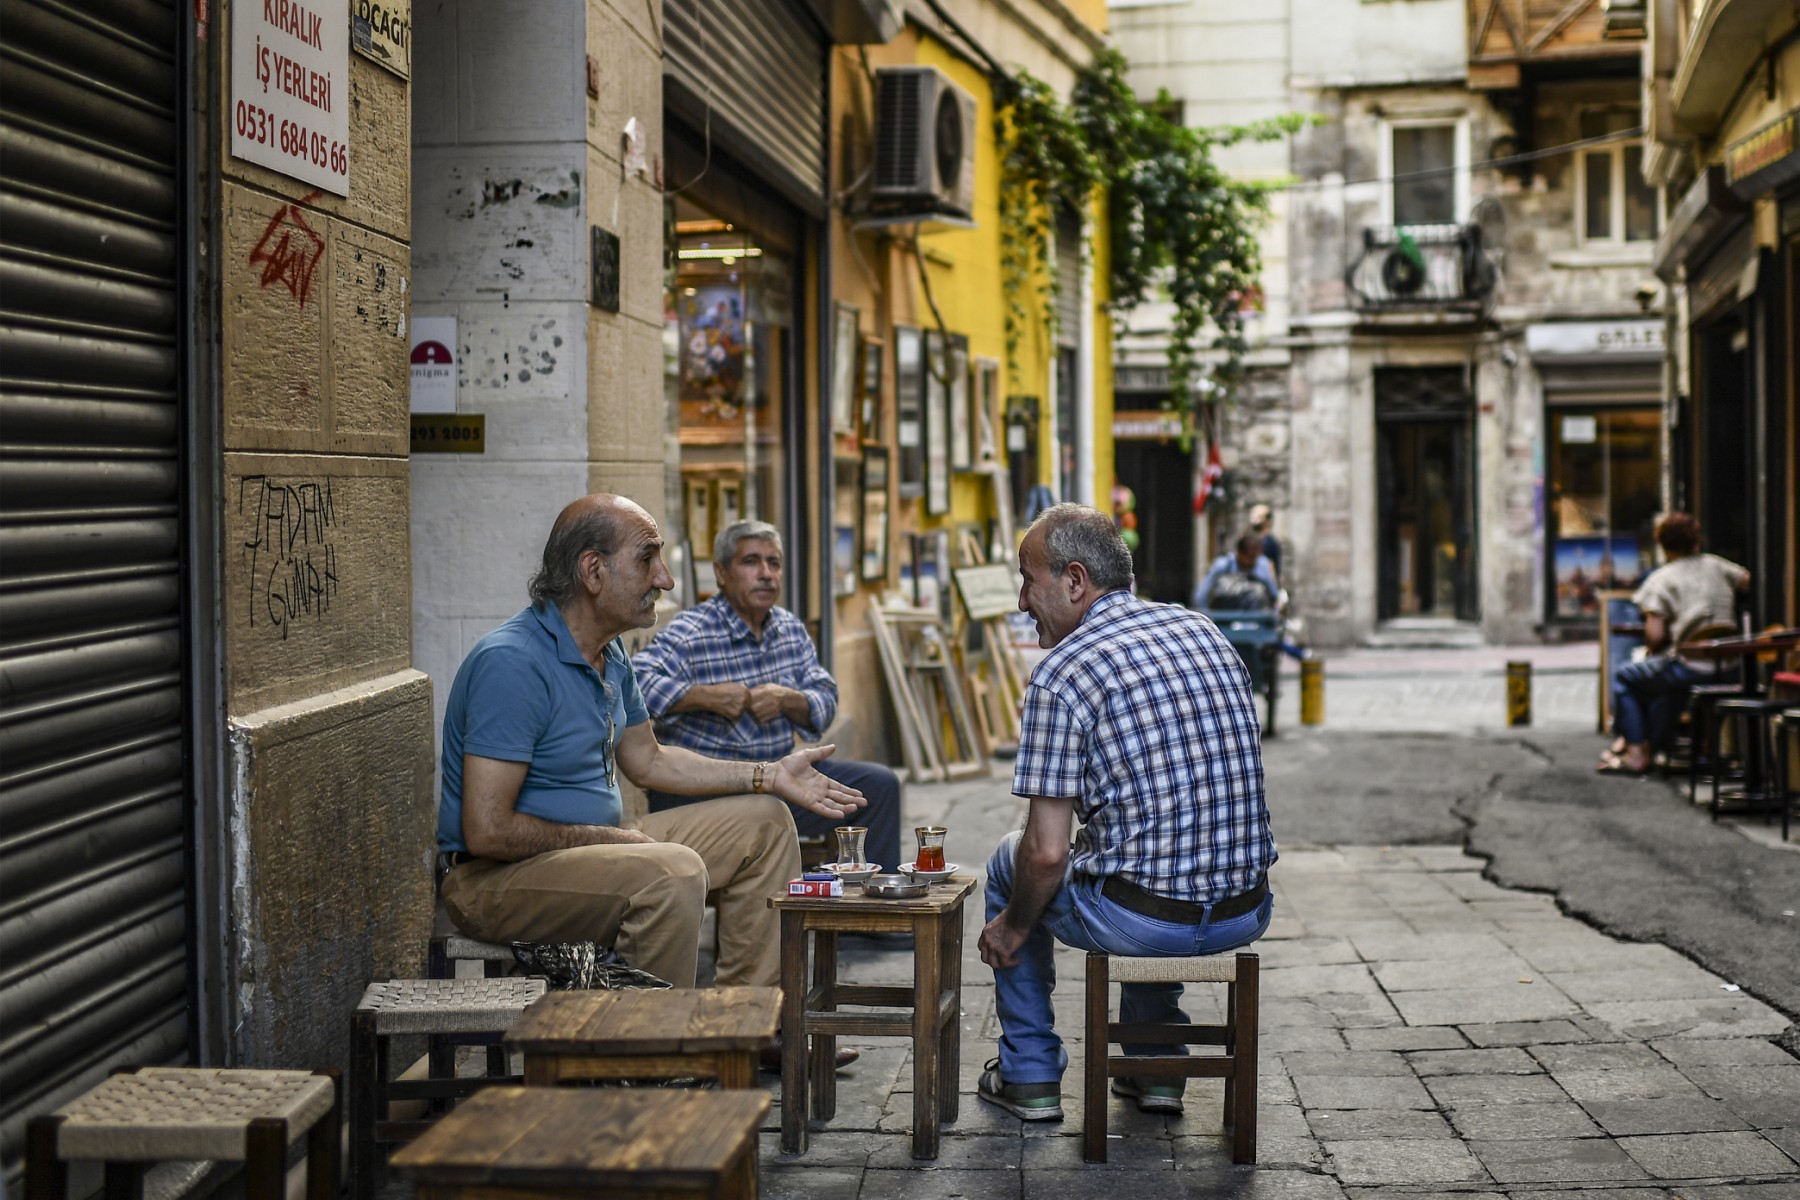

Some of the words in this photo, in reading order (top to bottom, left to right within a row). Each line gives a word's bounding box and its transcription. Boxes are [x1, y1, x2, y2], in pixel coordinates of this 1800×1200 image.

[264, 0, 322, 51] KIRALIK
[360, 0, 404, 48] OCAĞI
[256, 35, 271, 93] İŞ
[273, 52, 331, 113] YERLERİ
[236, 99, 275, 149] 0531
[280, 119, 308, 161] 684
[311, 131, 328, 168] 05
[330, 141, 347, 176] 66
[442, 426, 481, 441] 2005
